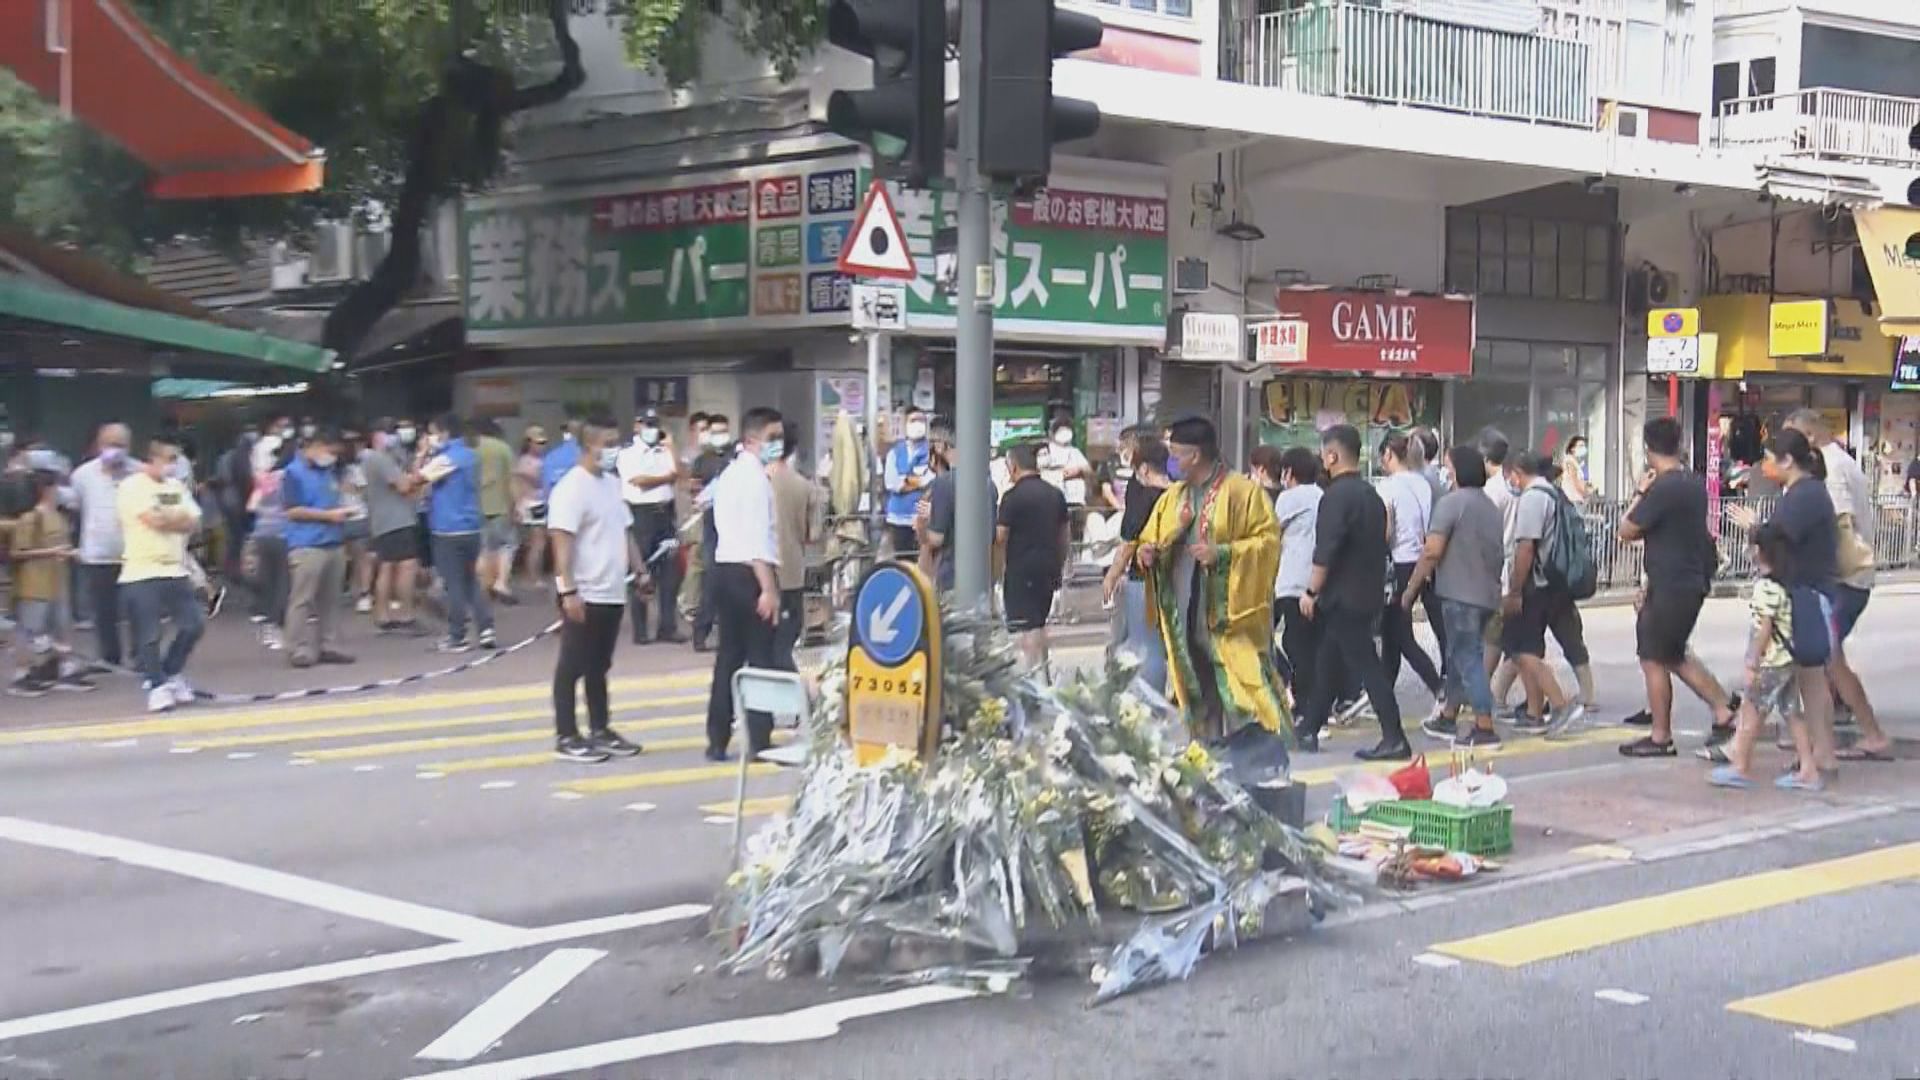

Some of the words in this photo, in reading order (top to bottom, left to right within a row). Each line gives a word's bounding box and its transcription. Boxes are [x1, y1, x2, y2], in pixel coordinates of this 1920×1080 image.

[759, 181, 801, 217] 食品
[468, 216, 749, 322] 業務スーパー
[1332, 301, 1417, 342] GAME
[1680, 358, 1694, 369] 12
[853, 675, 922, 696] 73052
